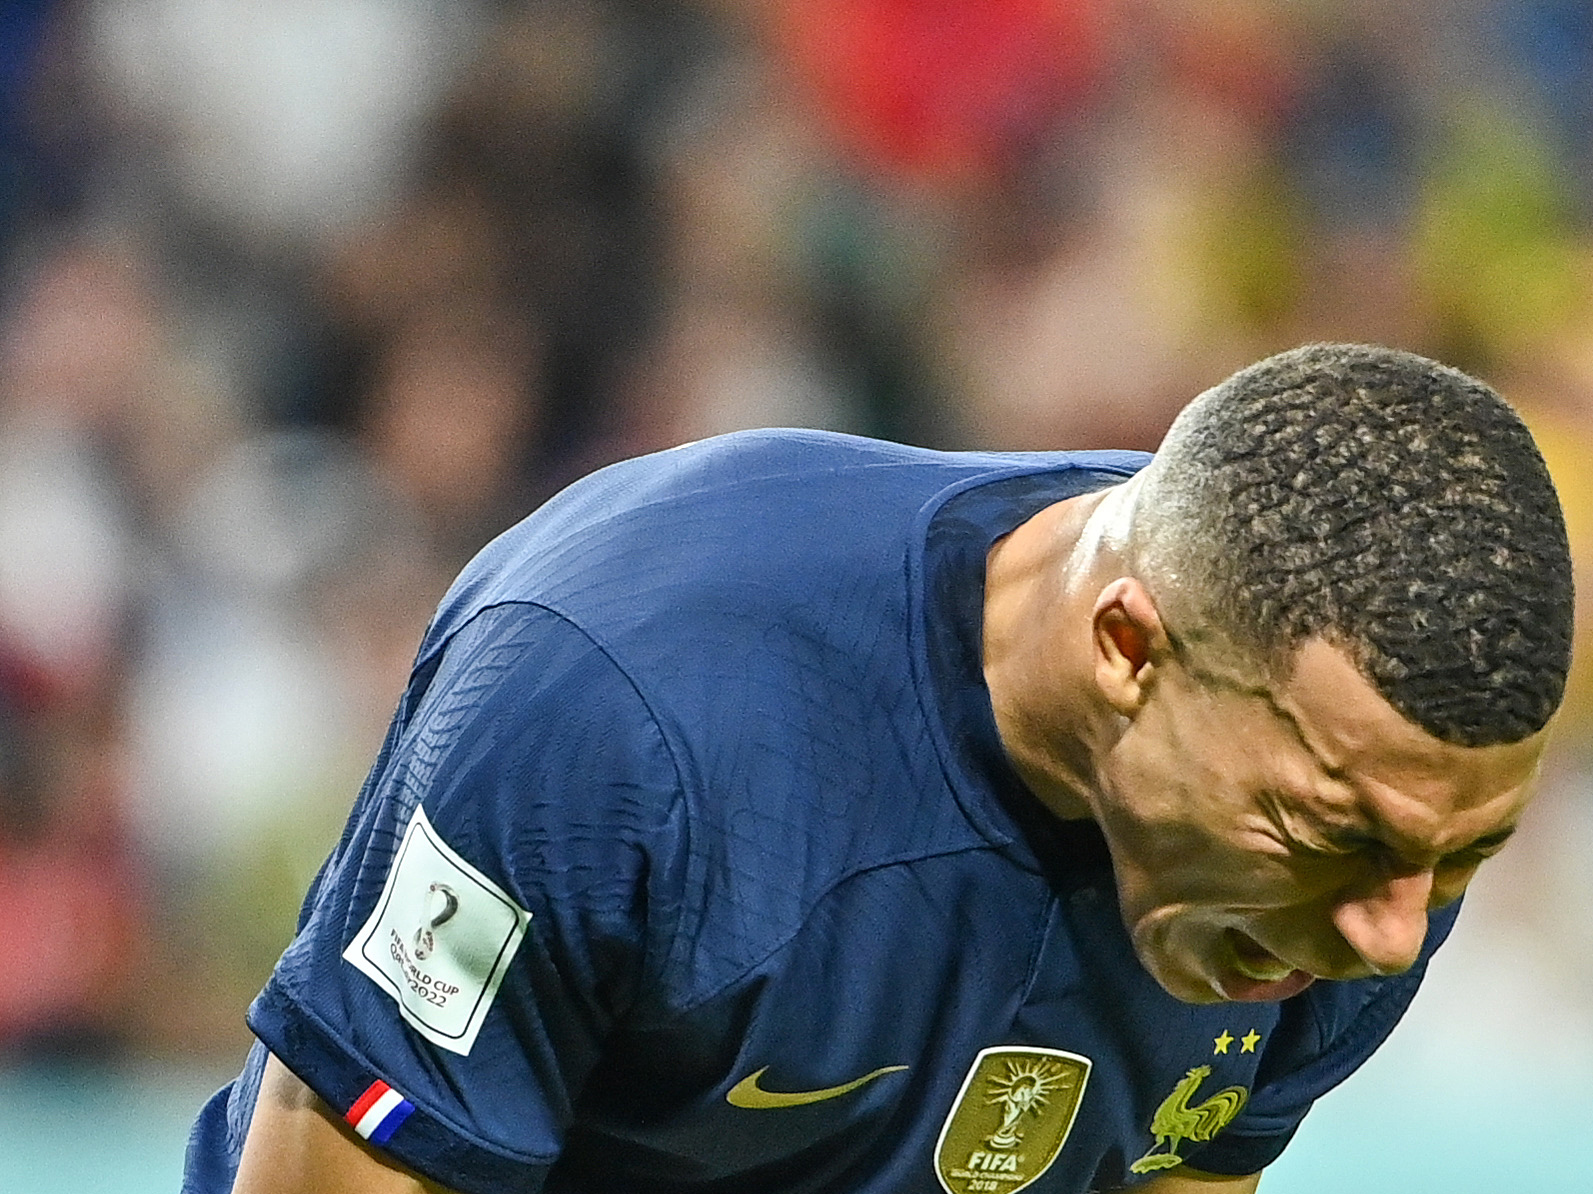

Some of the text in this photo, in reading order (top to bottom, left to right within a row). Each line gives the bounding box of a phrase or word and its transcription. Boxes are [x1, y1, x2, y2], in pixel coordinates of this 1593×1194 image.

[410, 980, 447, 1008] 2022
[434, 980, 460, 996] CUP
[967, 1151, 1017, 1172] FIFA
[967, 1179, 998, 1191] 2018
